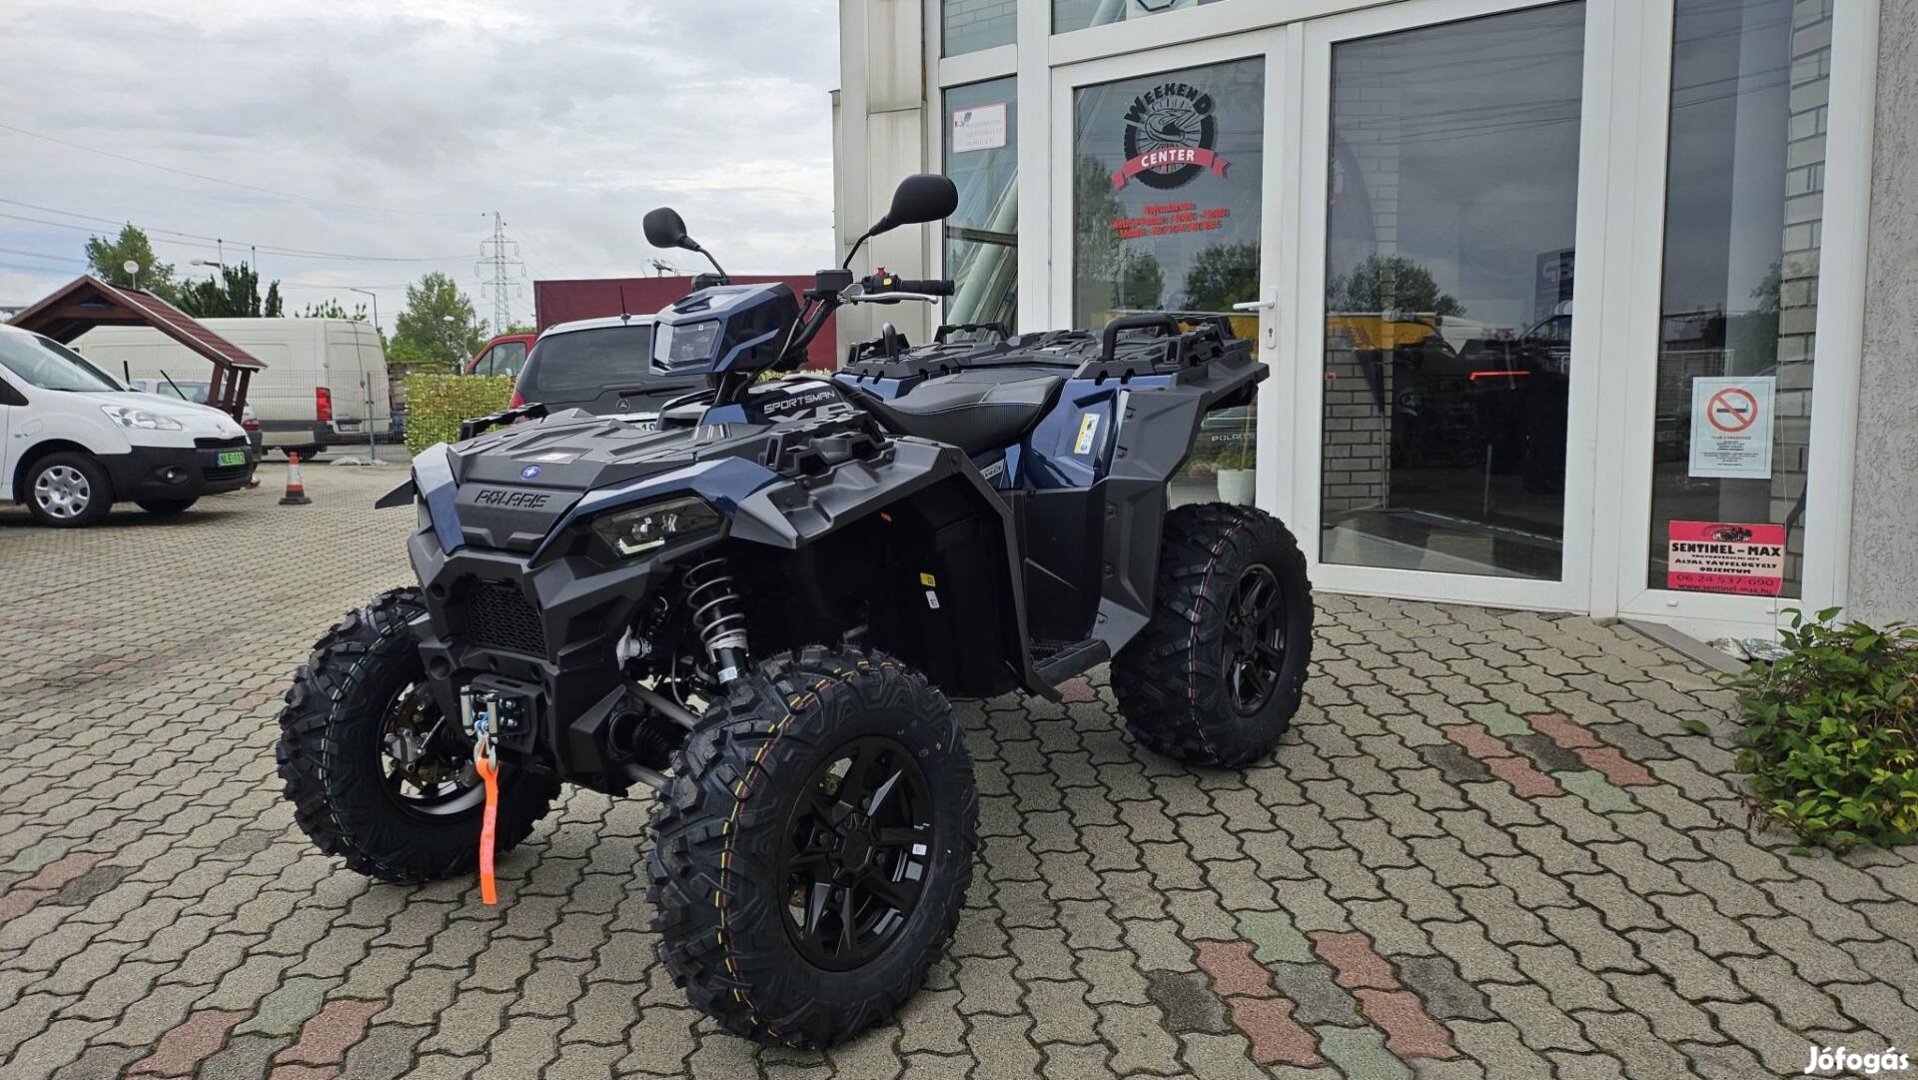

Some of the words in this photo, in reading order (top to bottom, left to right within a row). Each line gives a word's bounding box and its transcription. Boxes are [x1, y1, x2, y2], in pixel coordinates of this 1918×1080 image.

[1124, 83, 1212, 123] WEEKEND
[1141, 149, 1195, 168] CENTER
[764, 390, 835, 415] SPORTSMAN
[474, 489, 550, 508] POLARIS
[1672, 542, 1735, 555] SENTINEL
[1748, 546, 1781, 557] MAX
[1699, 566, 1751, 574] OBJEKTUM
